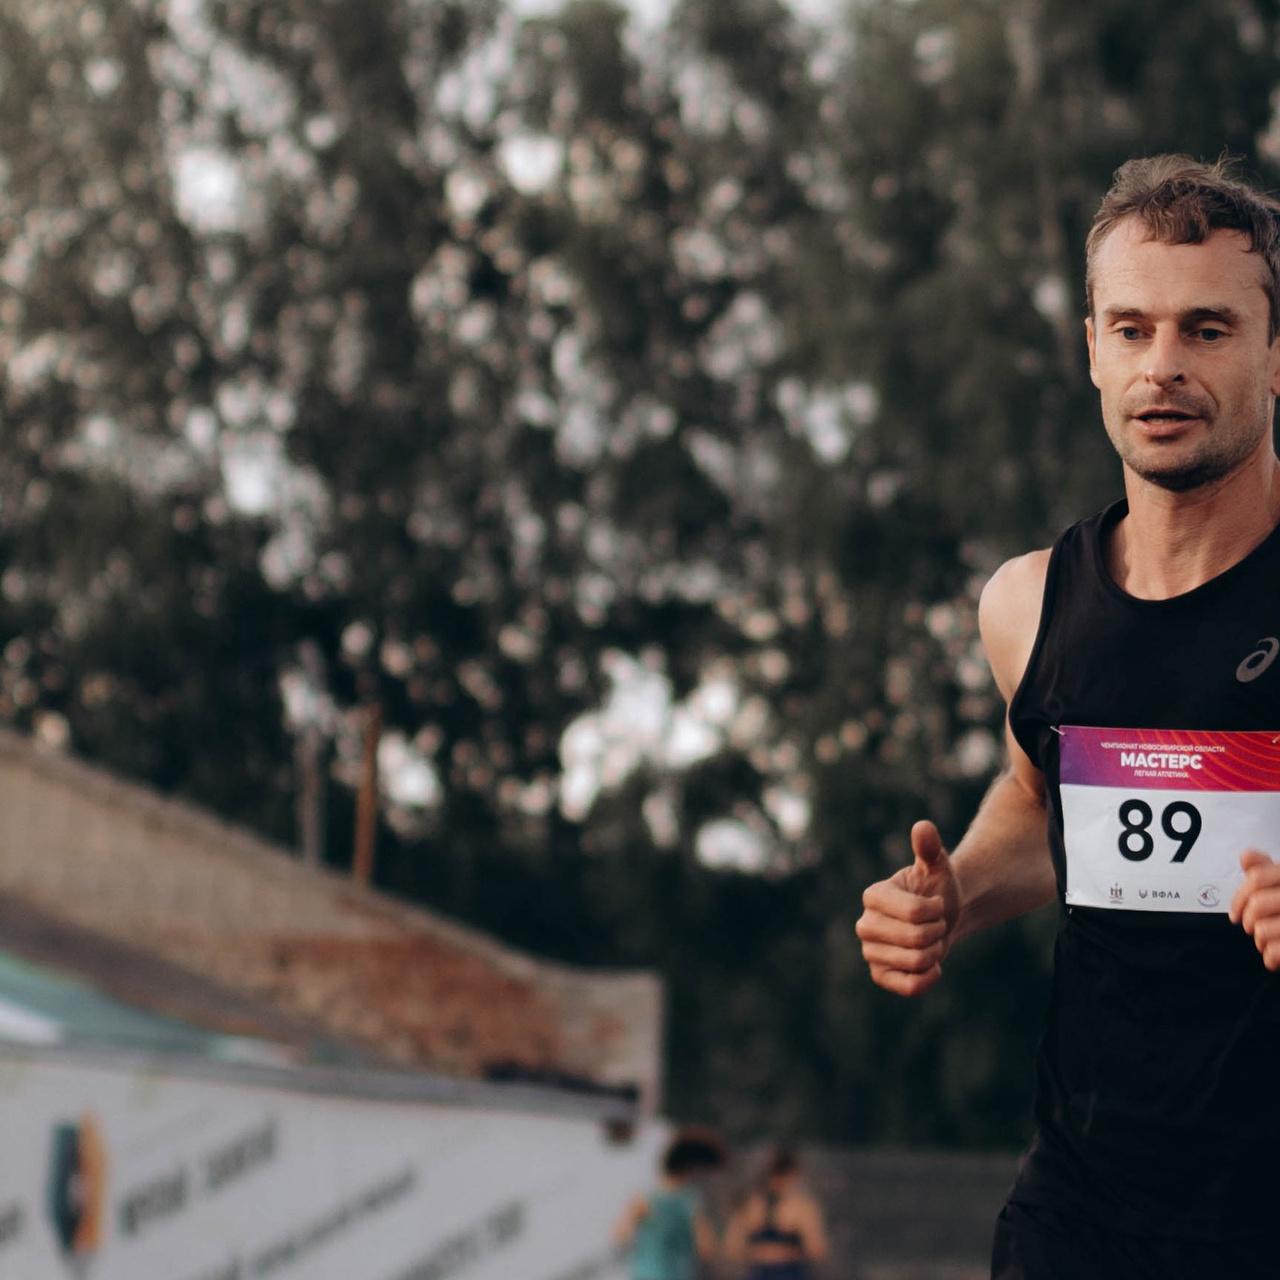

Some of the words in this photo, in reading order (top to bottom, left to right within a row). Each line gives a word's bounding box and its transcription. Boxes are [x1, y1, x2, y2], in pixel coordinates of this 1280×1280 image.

[1120, 752, 1203, 770] МАСТЕРС
[1118, 798, 1202, 863] 89
[1152, 890, 1181, 899] ВФЛА
